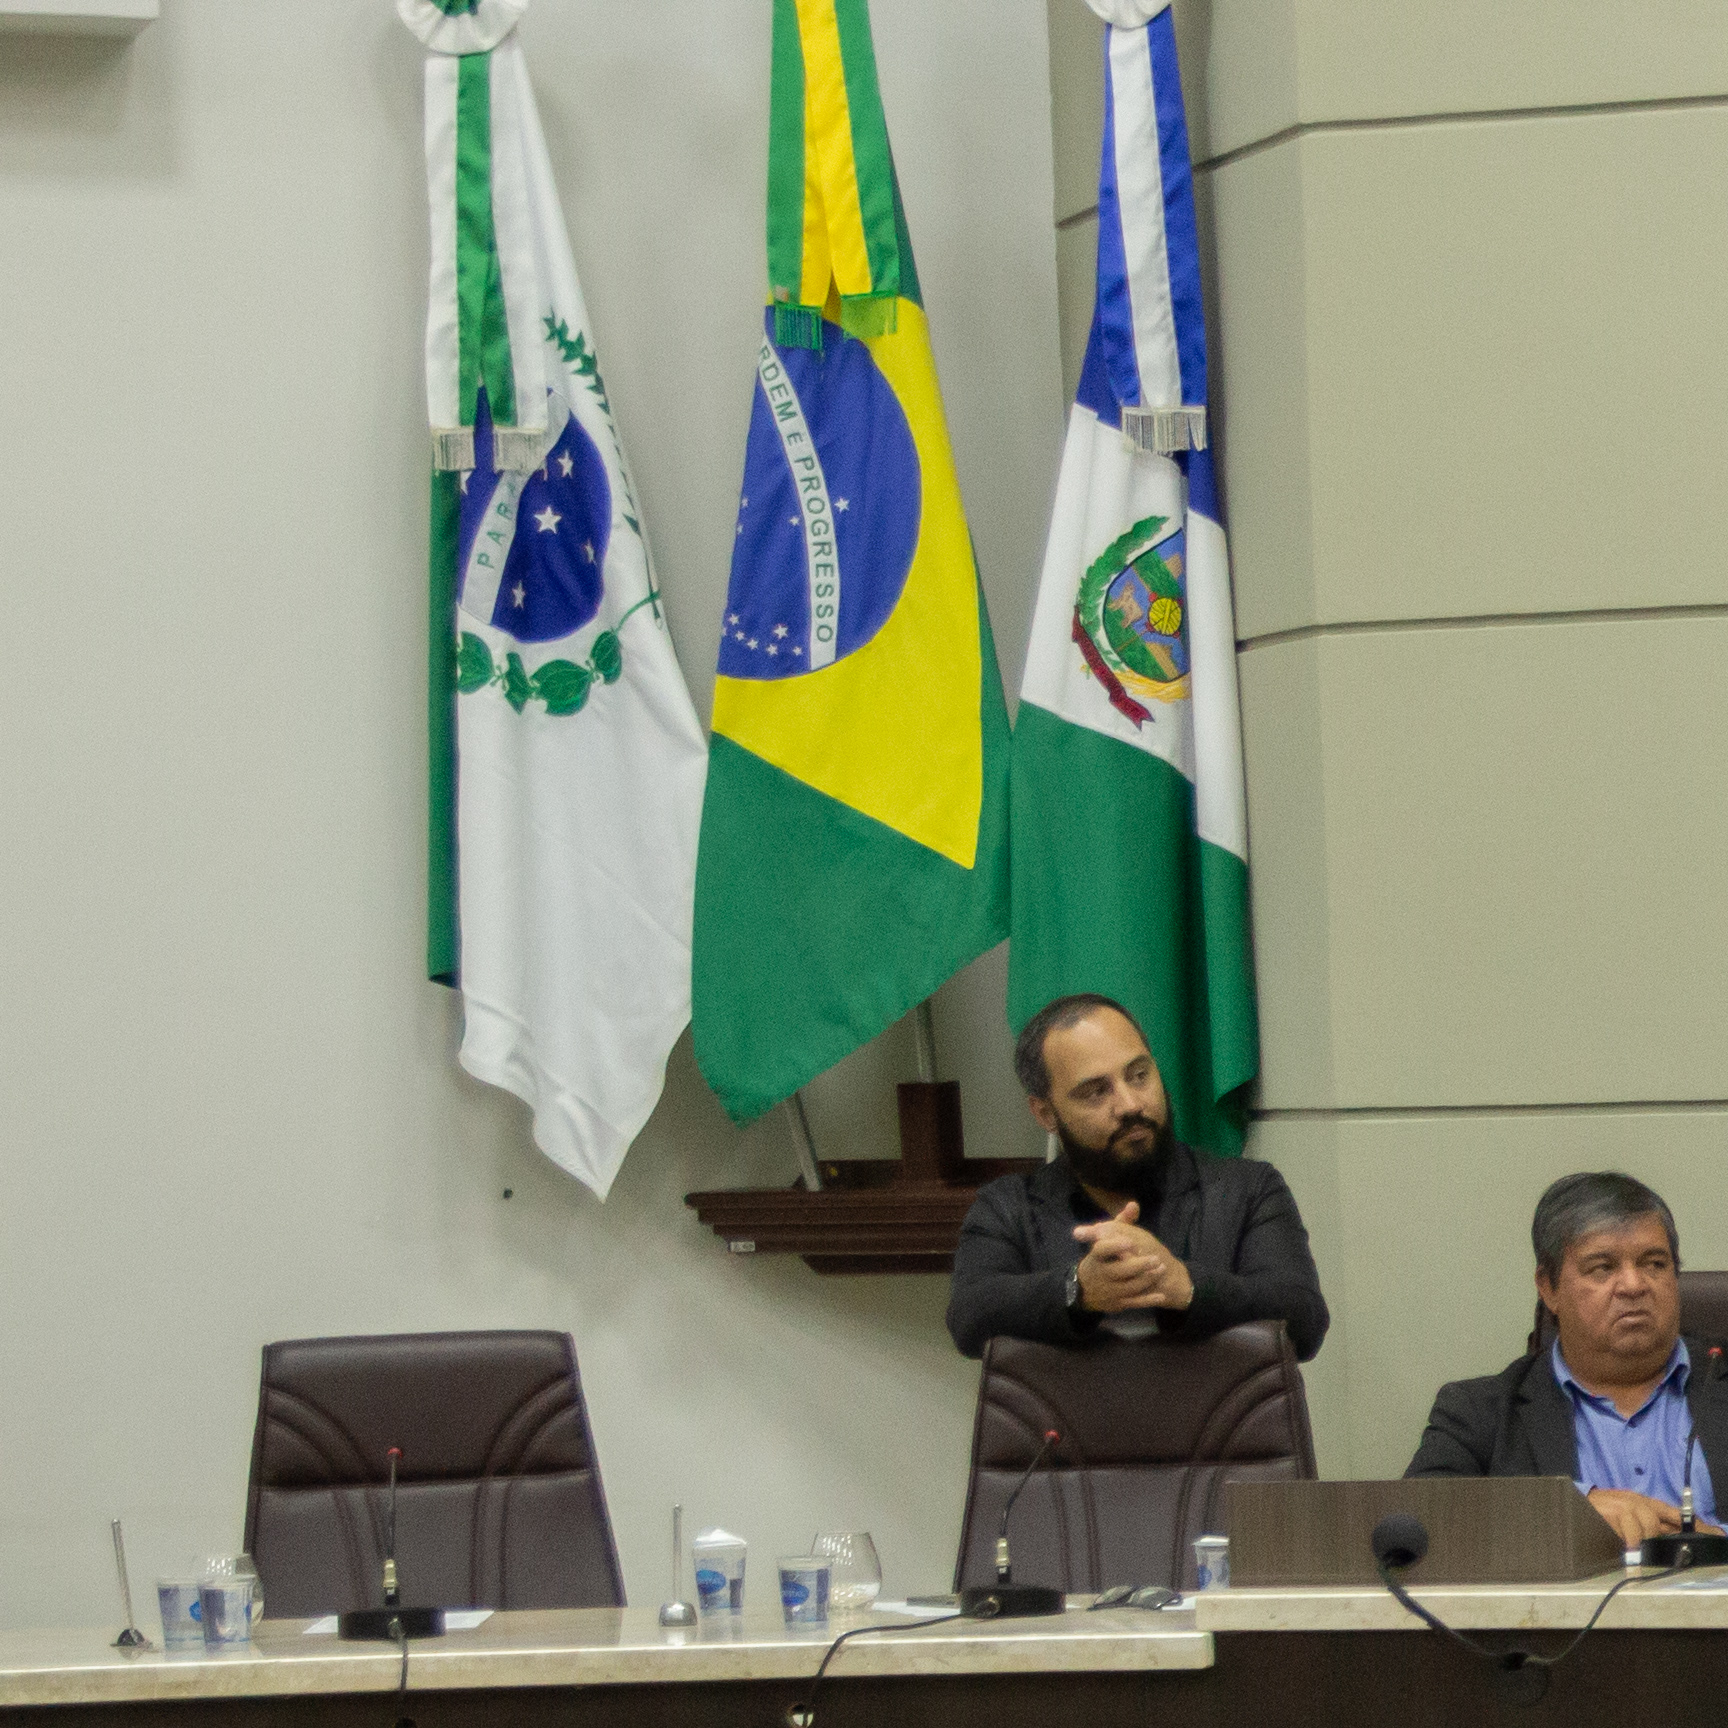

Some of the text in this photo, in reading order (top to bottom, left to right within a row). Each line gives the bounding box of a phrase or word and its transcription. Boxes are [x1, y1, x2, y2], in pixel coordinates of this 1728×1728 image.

[759, 345, 834, 643] RDEM E PROGRESSO
